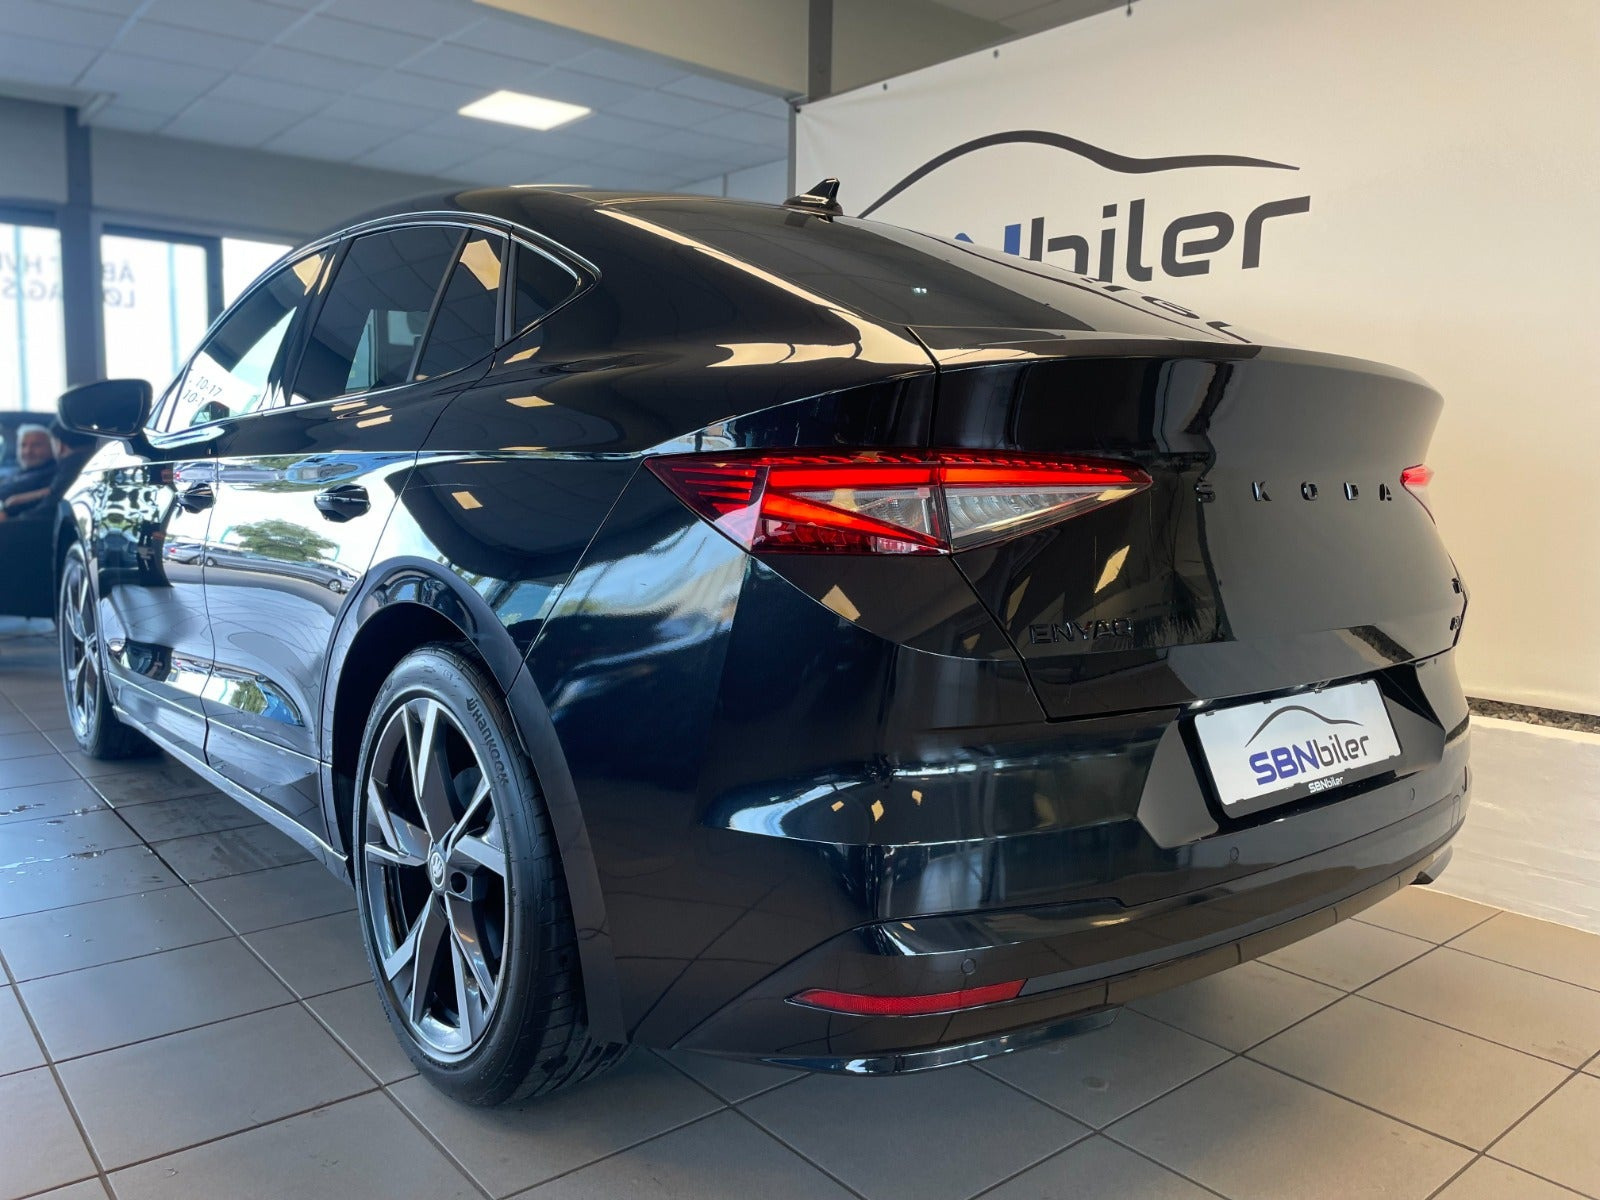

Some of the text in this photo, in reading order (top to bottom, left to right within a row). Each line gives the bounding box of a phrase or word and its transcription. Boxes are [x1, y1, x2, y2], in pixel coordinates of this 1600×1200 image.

[182, 389, 206, 407] 10-1
[1029, 617, 1134, 644] ENYAQ
[1249, 734, 1369, 786] SBNbiler
[1308, 776, 1344, 794] SBNbiler
